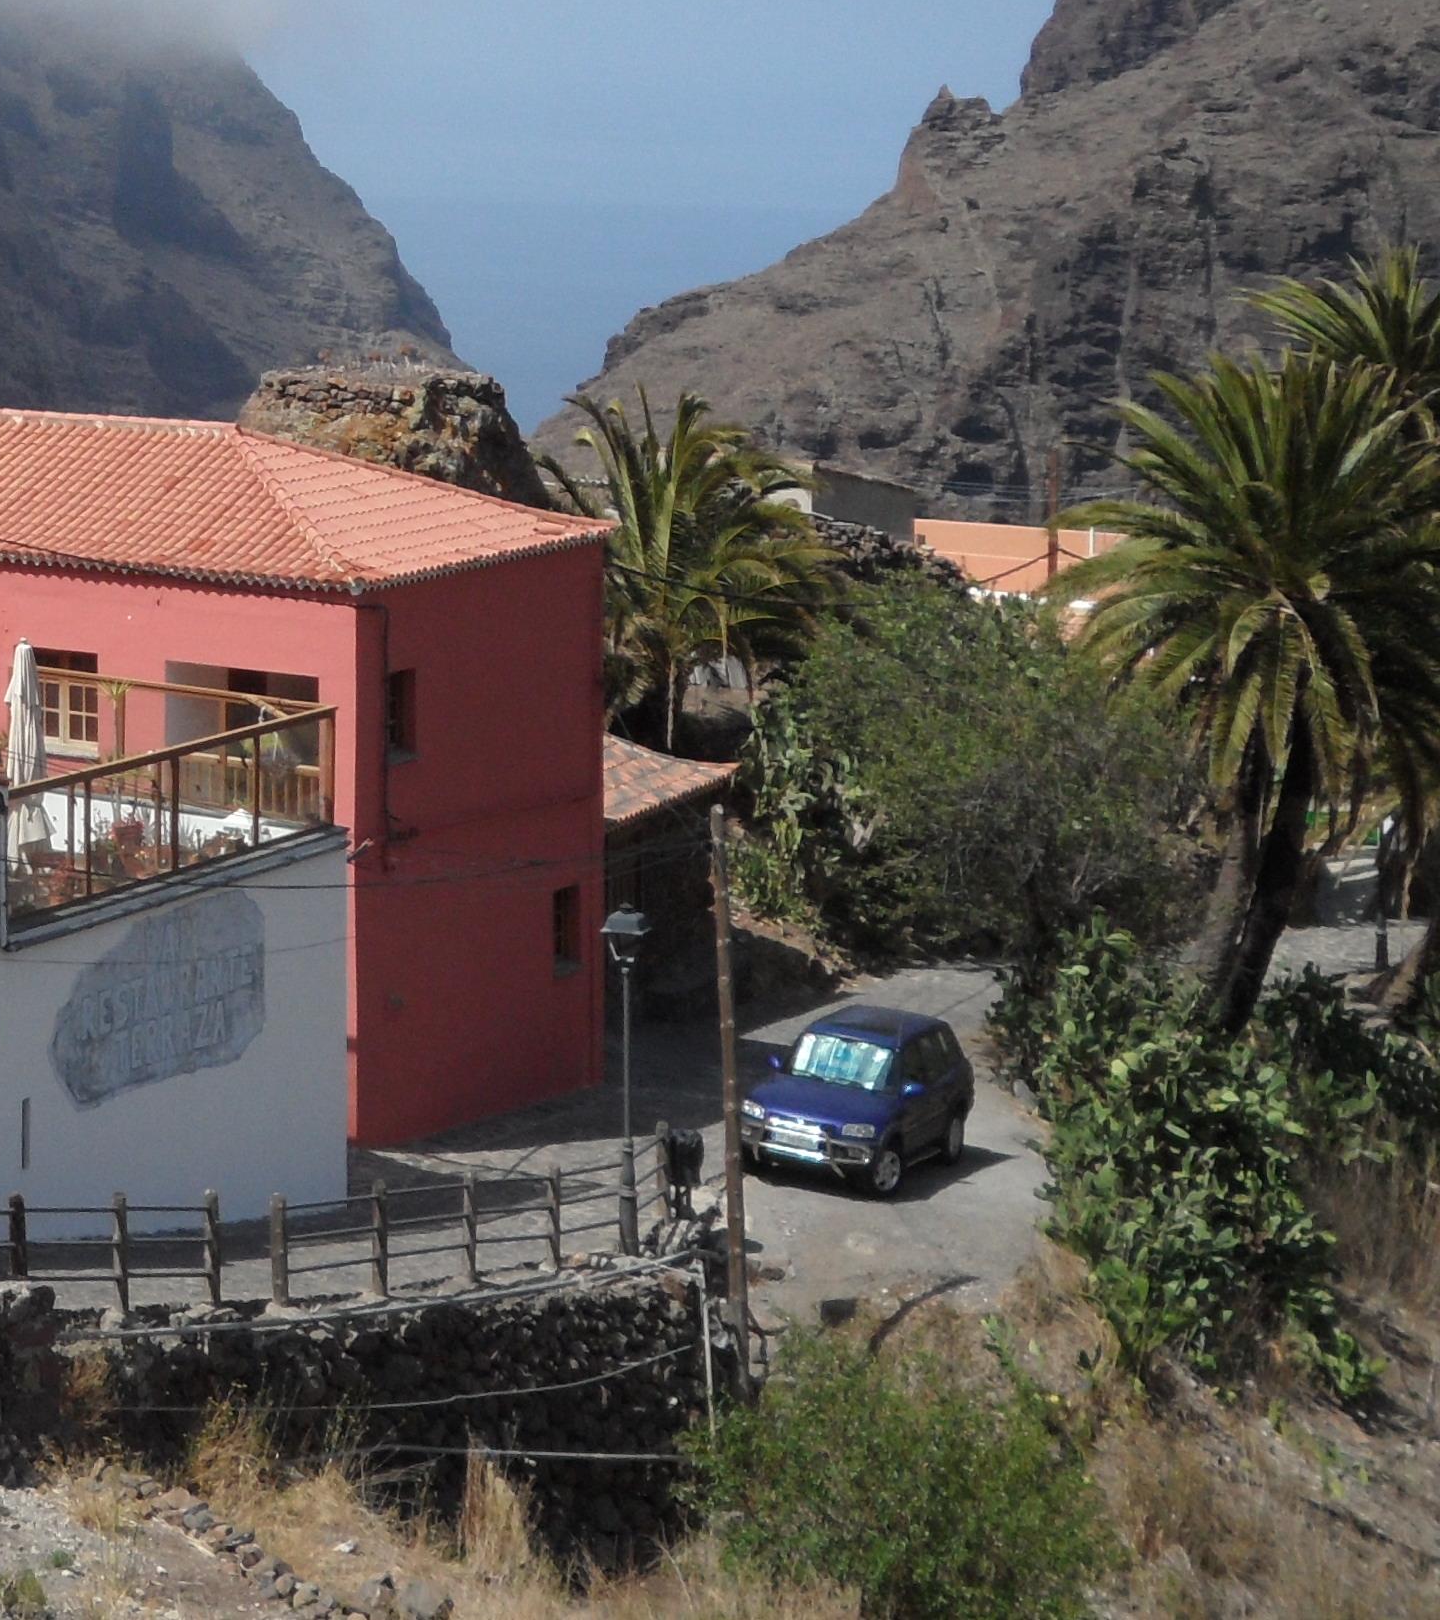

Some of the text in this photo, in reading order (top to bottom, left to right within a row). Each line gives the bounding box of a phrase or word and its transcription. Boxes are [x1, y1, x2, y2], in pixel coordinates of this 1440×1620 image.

[146, 917, 200, 963] BAR
[77, 944, 254, 1041] RESTAURANTE
[112, 1000, 227, 1077] TERRAZA
